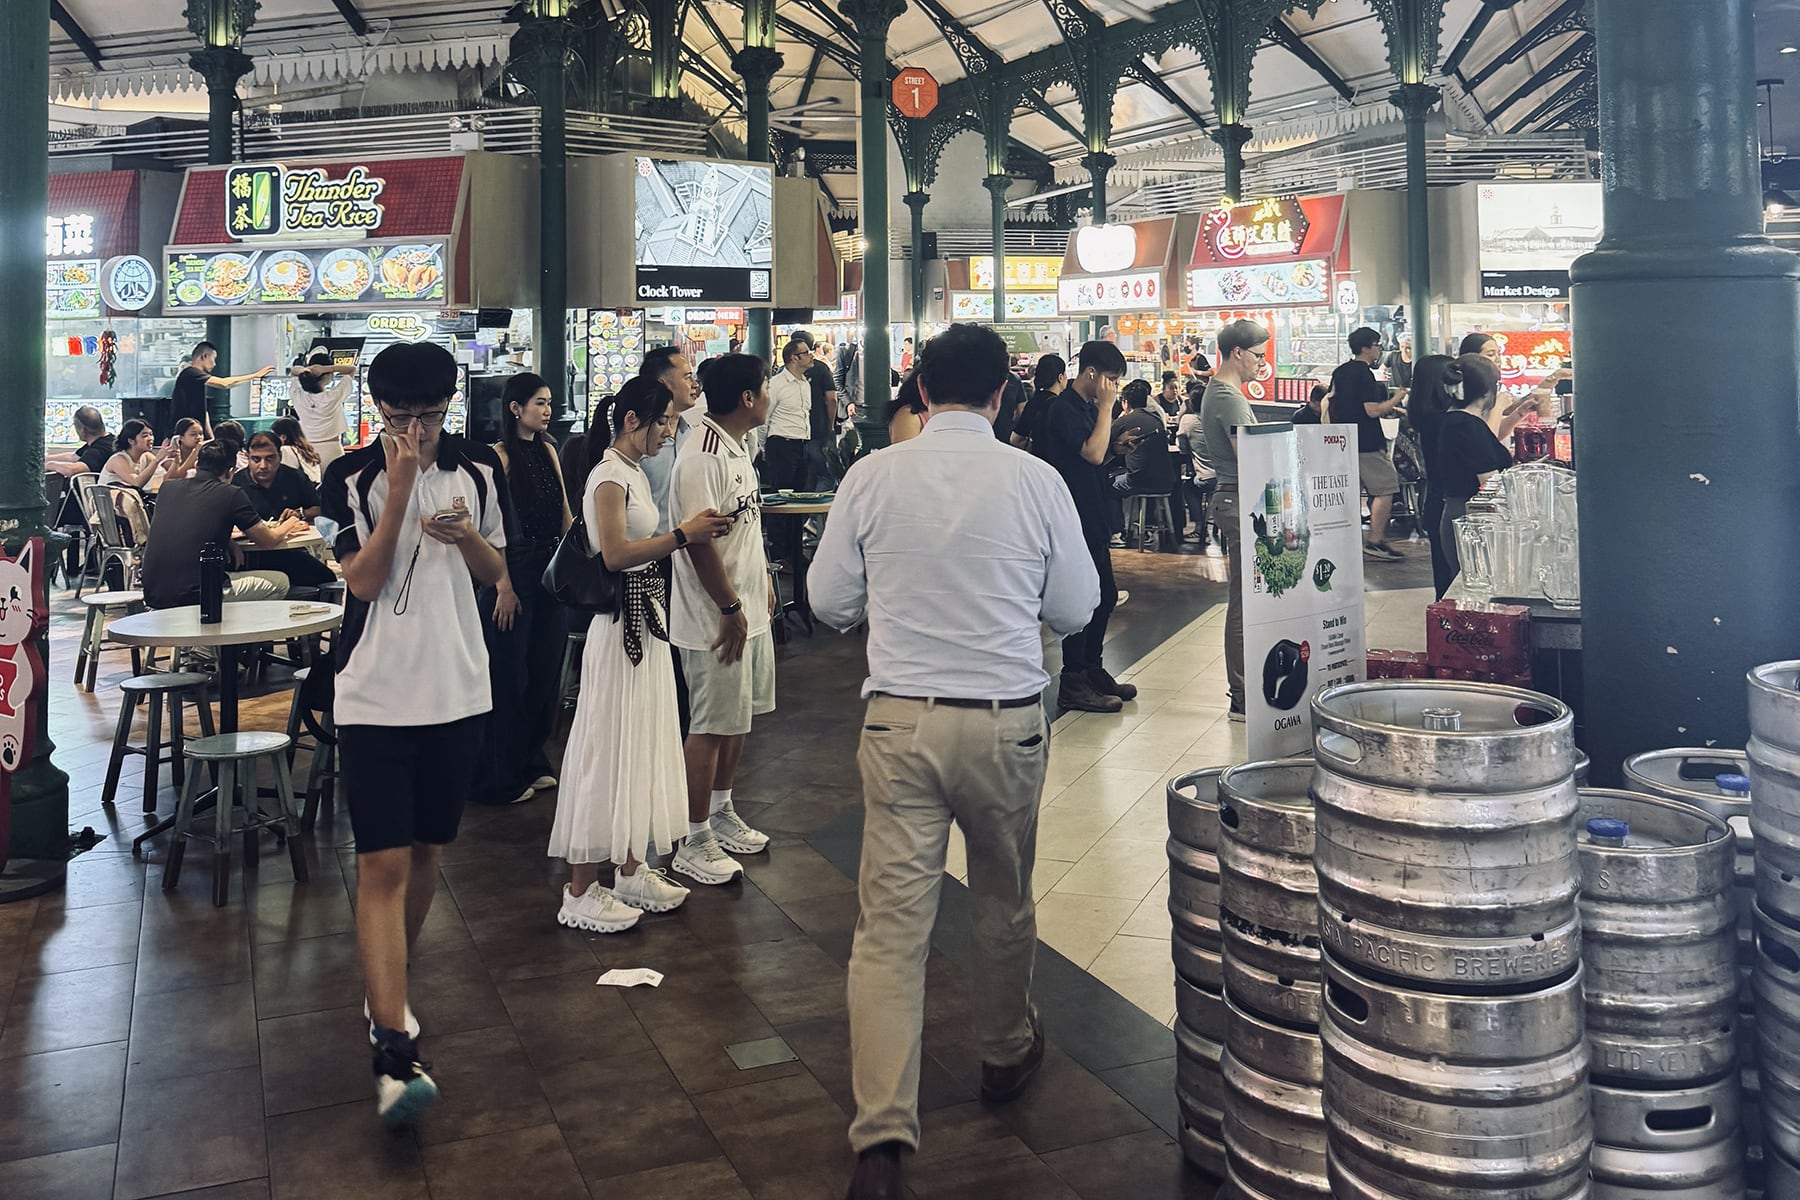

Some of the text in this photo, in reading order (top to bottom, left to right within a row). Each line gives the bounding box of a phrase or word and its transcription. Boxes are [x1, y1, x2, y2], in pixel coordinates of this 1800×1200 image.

[904, 77, 925, 86] STREET
[911, 87, 920, 109] 1
[285, 172, 378, 203] Thunder
[287, 200, 377, 228] Tea Rice
[638, 284, 703, 298] Clock Tower
[1484, 284, 1560, 297] Market Design
[369, 316, 415, 328] ORDER
[686, 310, 740, 321] ORDER HERE
[1323, 435, 1339, 444] POKKA
[1312, 474, 1348, 489] THE TASTE
[1313, 492, 1344, 510] OF JAPAN
[1323, 618, 1335, 629] Stand
[1335, 618, 1340, 626] to
[1274, 715, 1302, 730] OGAWA
[1353, 937, 1436, 972] PACIFIC
[1453, 944, 1569, 978] BREWERIES
